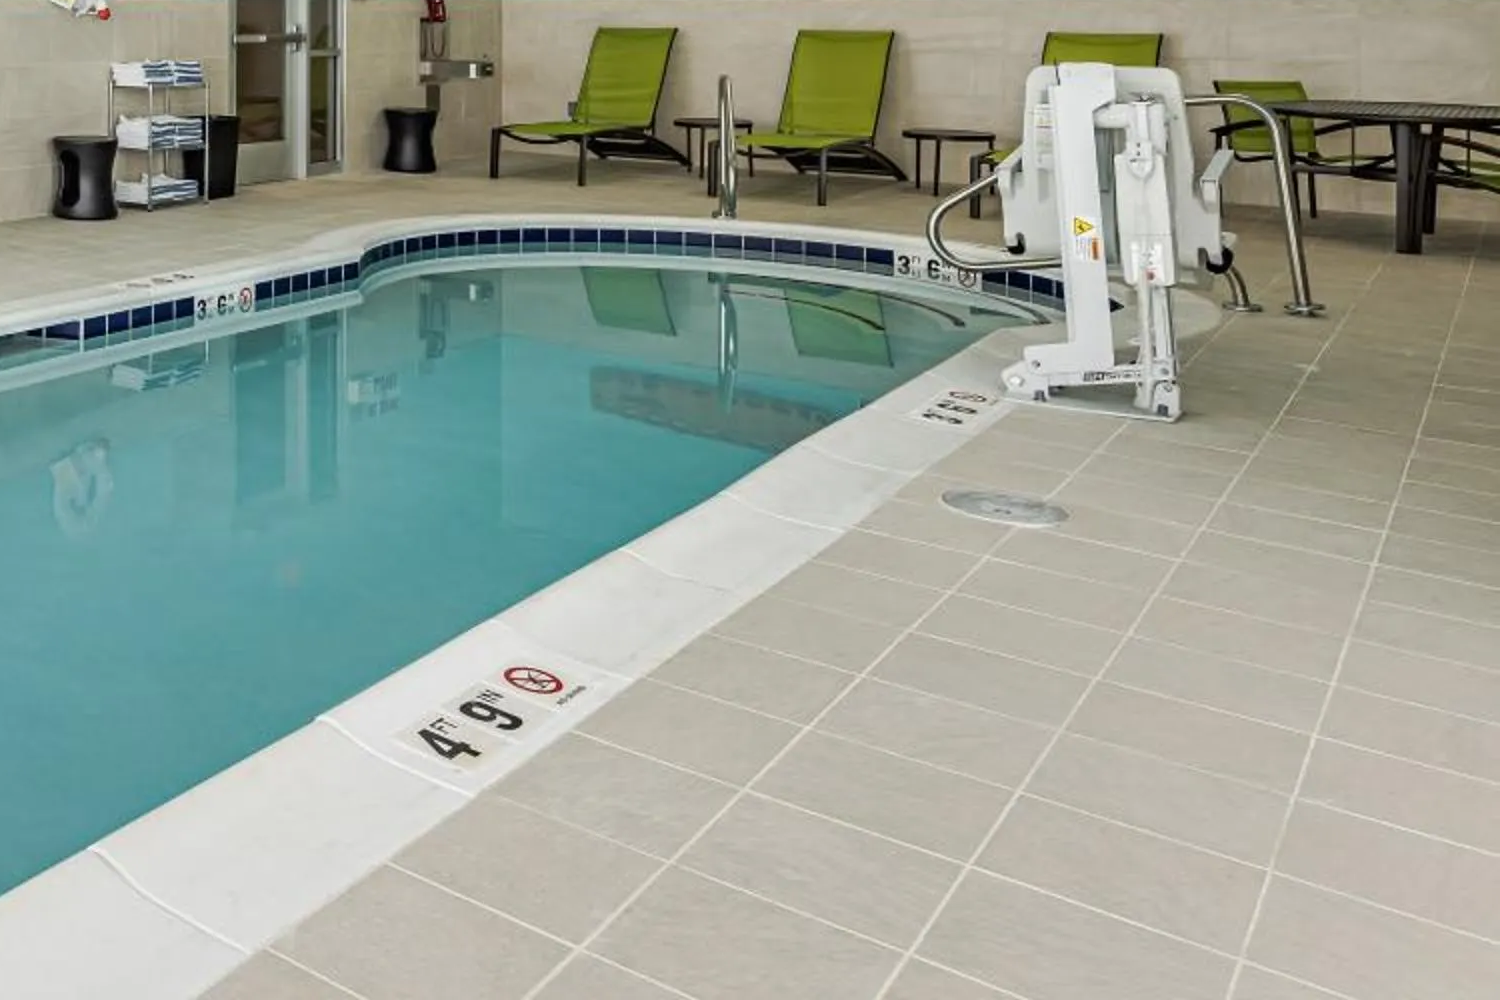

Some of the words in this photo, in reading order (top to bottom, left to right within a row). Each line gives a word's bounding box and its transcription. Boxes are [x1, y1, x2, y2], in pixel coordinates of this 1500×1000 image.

[898, 256, 910, 274] 3
[429, 717, 458, 735] FT
[459, 700, 523, 731] 9
[417, 728, 482, 760] 4
